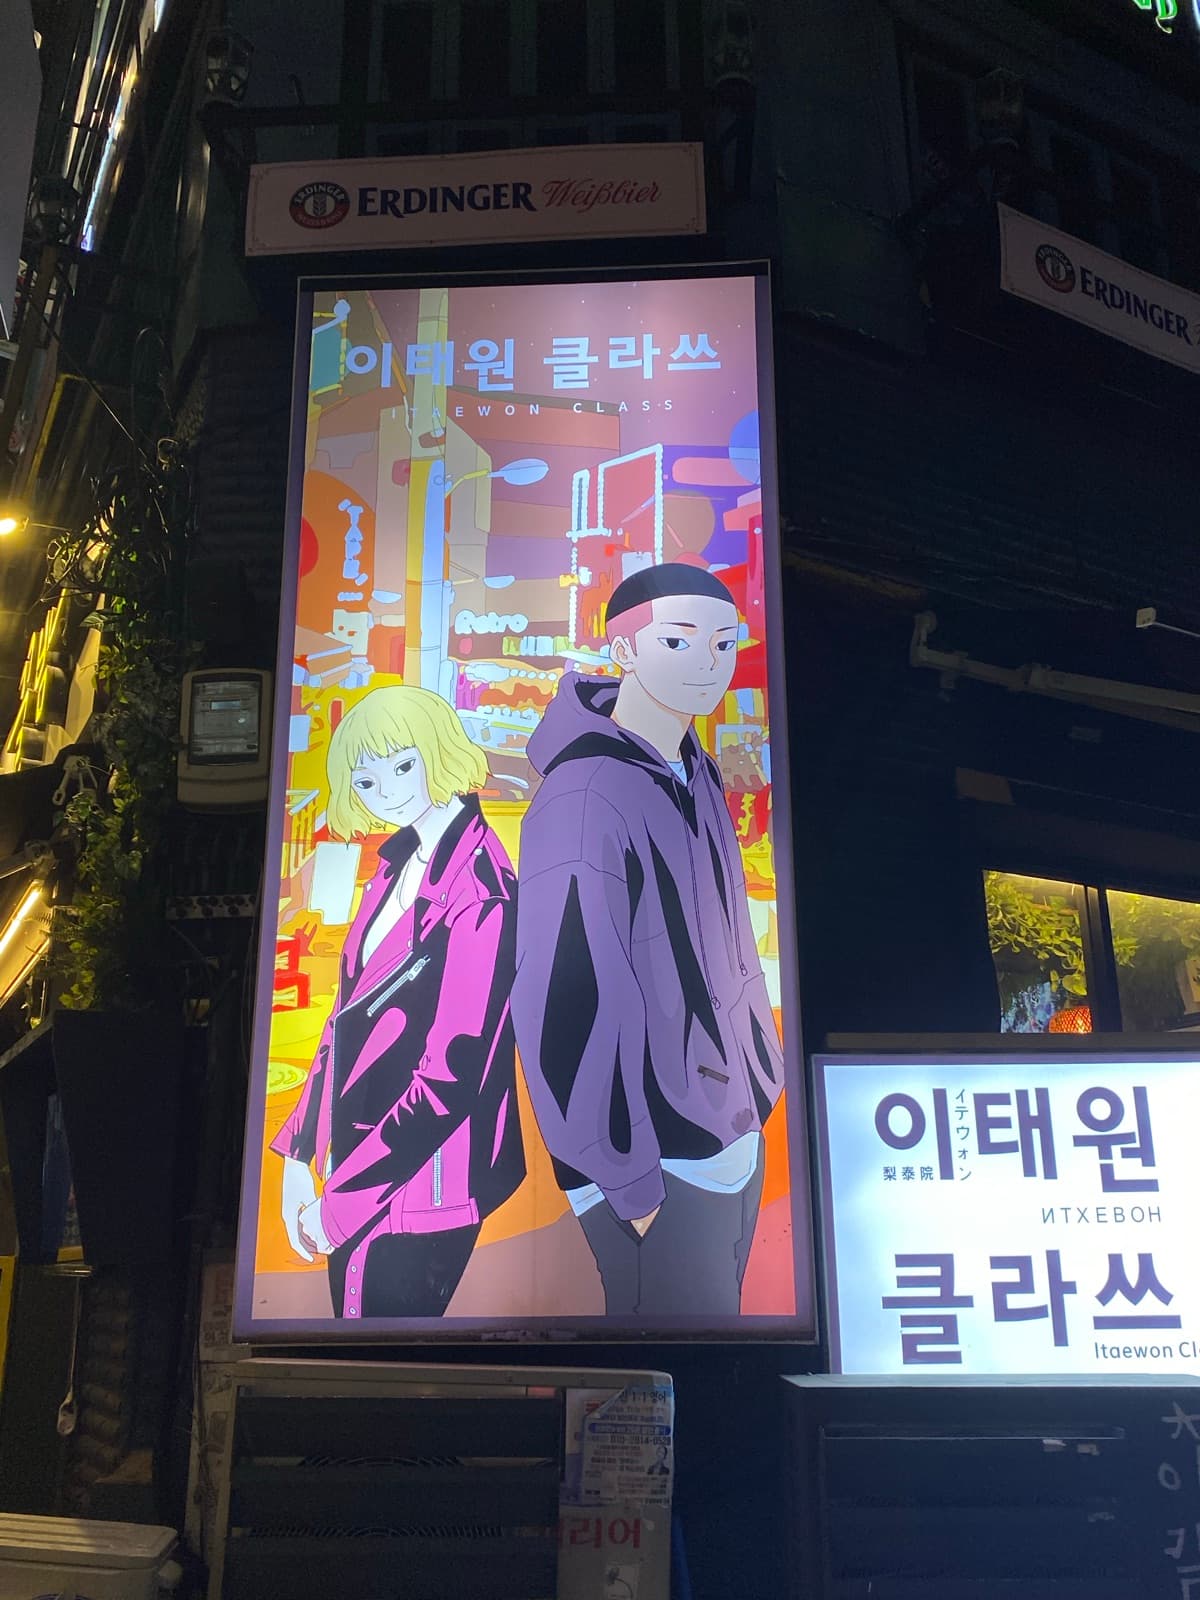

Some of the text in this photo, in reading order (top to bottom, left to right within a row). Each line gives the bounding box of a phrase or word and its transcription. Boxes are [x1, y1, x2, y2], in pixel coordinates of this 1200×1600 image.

[357, 182, 538, 218] ERDINGER
[542, 177, 662, 213] Weißbier
[1079, 265, 1193, 346] ERDINGER
[345, 333, 722, 392] 이태원 클라쓰
[391, 399, 673, 419] ITAEWON CLASS
[874, 1085, 1160, 1193] 이태원
[882, 1165, 934, 1181] 梨泰院
[1041, 1205, 1162, 1224] ИТХЕВОН
[881, 1249, 1182, 1365] 클라쓰
[1094, 1340, 1200, 1359] Itaewon Cl
[557, 1517, 642, 1549] 리어
